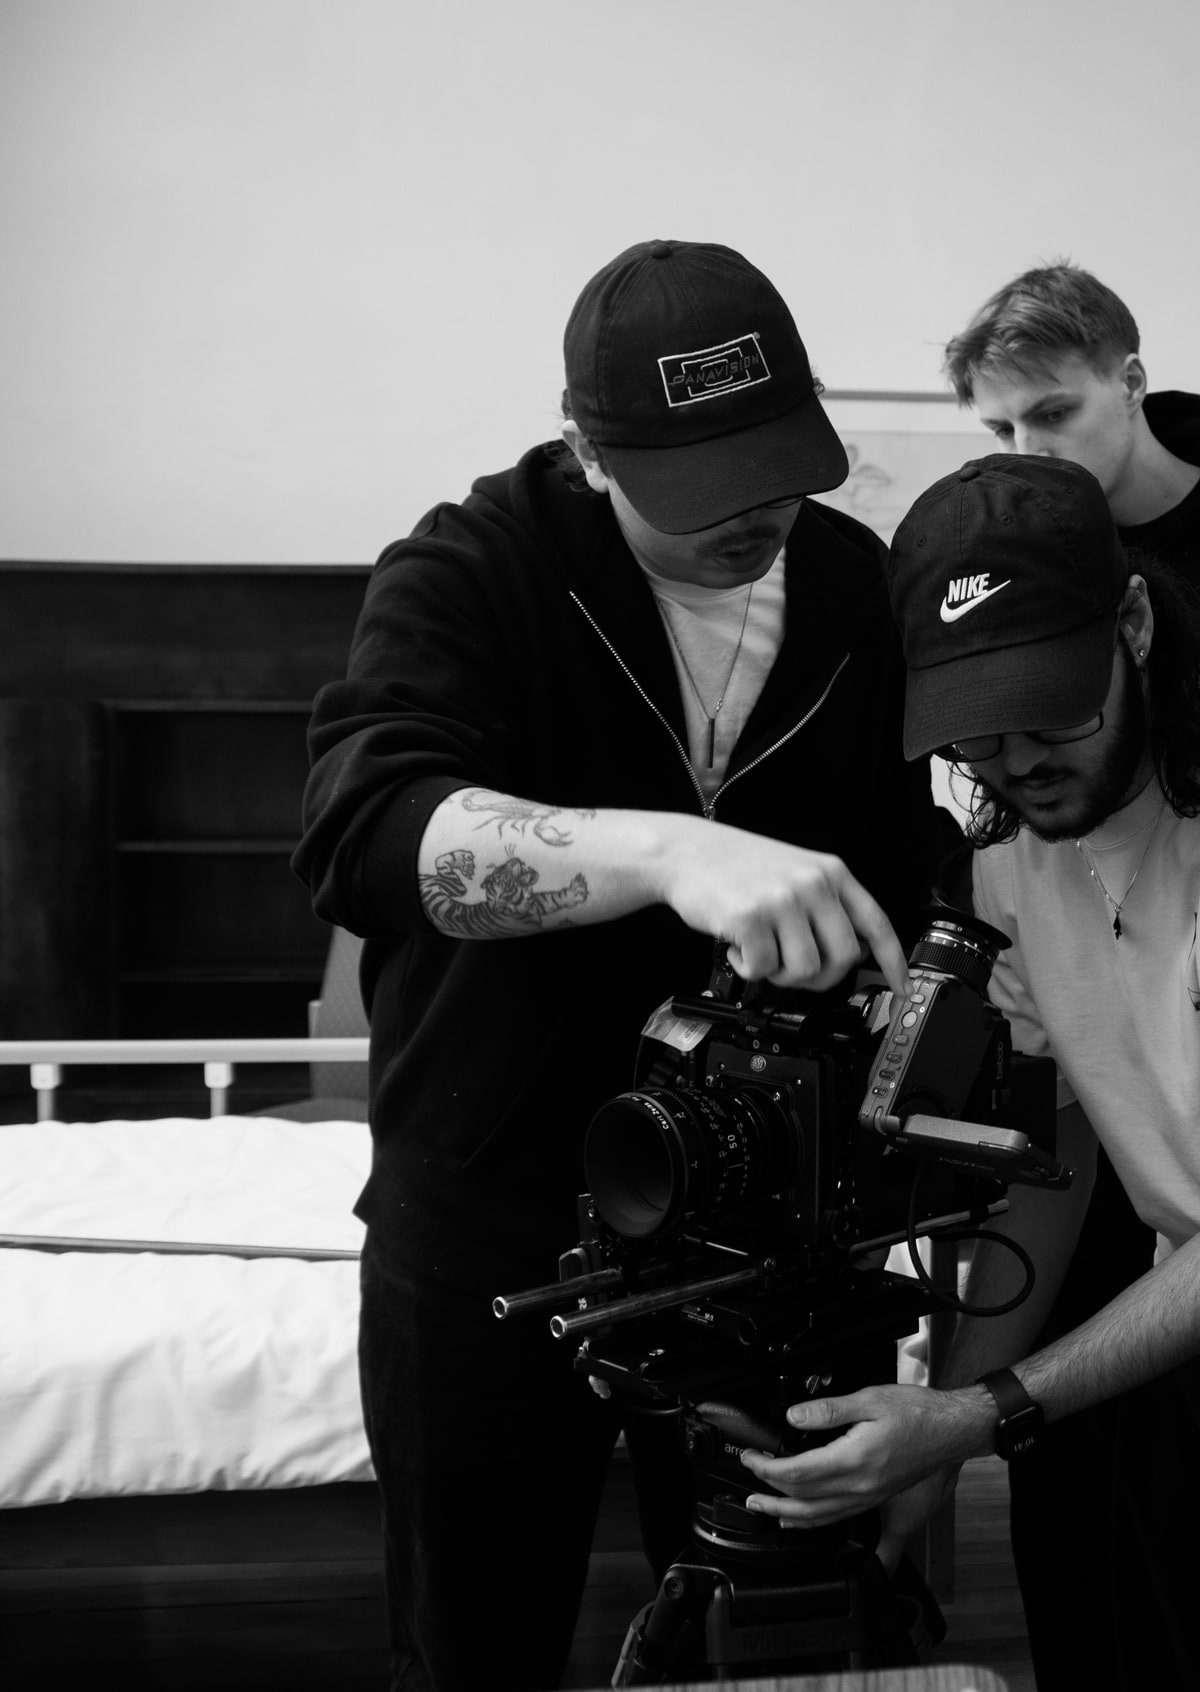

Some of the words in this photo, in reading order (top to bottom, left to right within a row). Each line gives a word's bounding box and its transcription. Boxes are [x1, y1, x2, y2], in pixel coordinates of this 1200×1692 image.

[667, 353, 760, 387] PANAVISION
[947, 572, 990, 603] NIKE
[727, 1134, 738, 1149] 50
